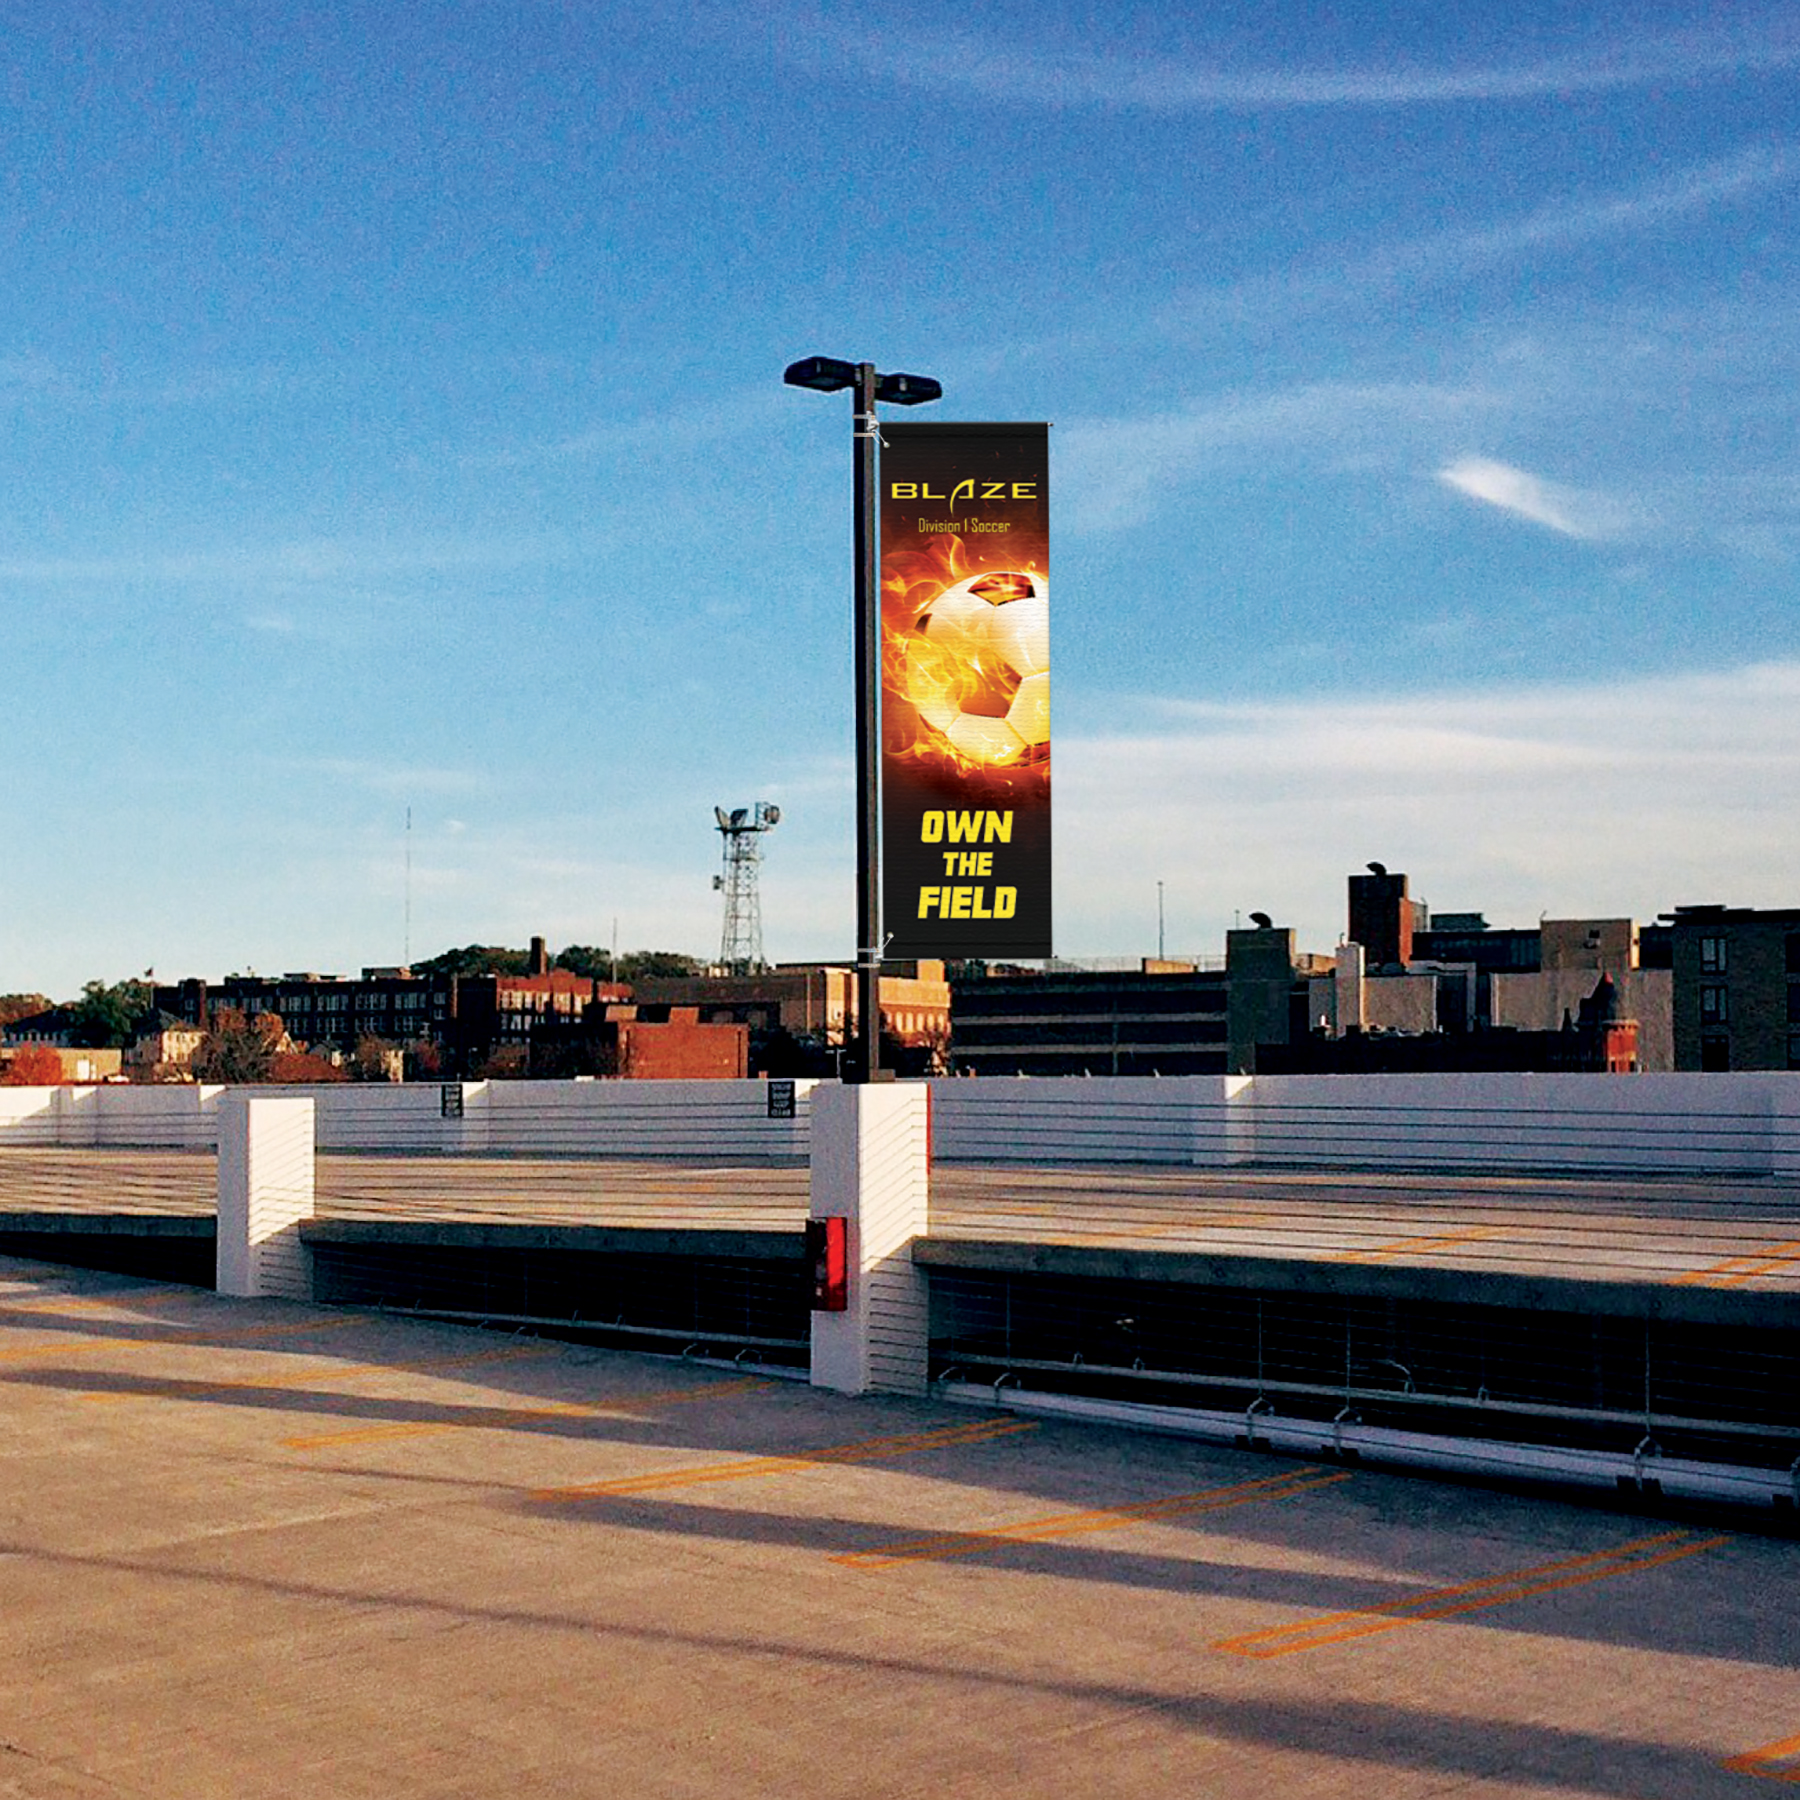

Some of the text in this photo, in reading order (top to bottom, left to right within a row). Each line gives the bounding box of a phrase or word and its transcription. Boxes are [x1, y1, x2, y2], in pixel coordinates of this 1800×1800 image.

[891, 478, 1037, 514] BLAZE
[918, 518, 960, 533] Division
[971, 518, 1011, 533] Soccer
[920, 810, 1014, 843] OWN
[942, 851, 994, 876] THE
[917, 886, 1018, 919] FIELD
